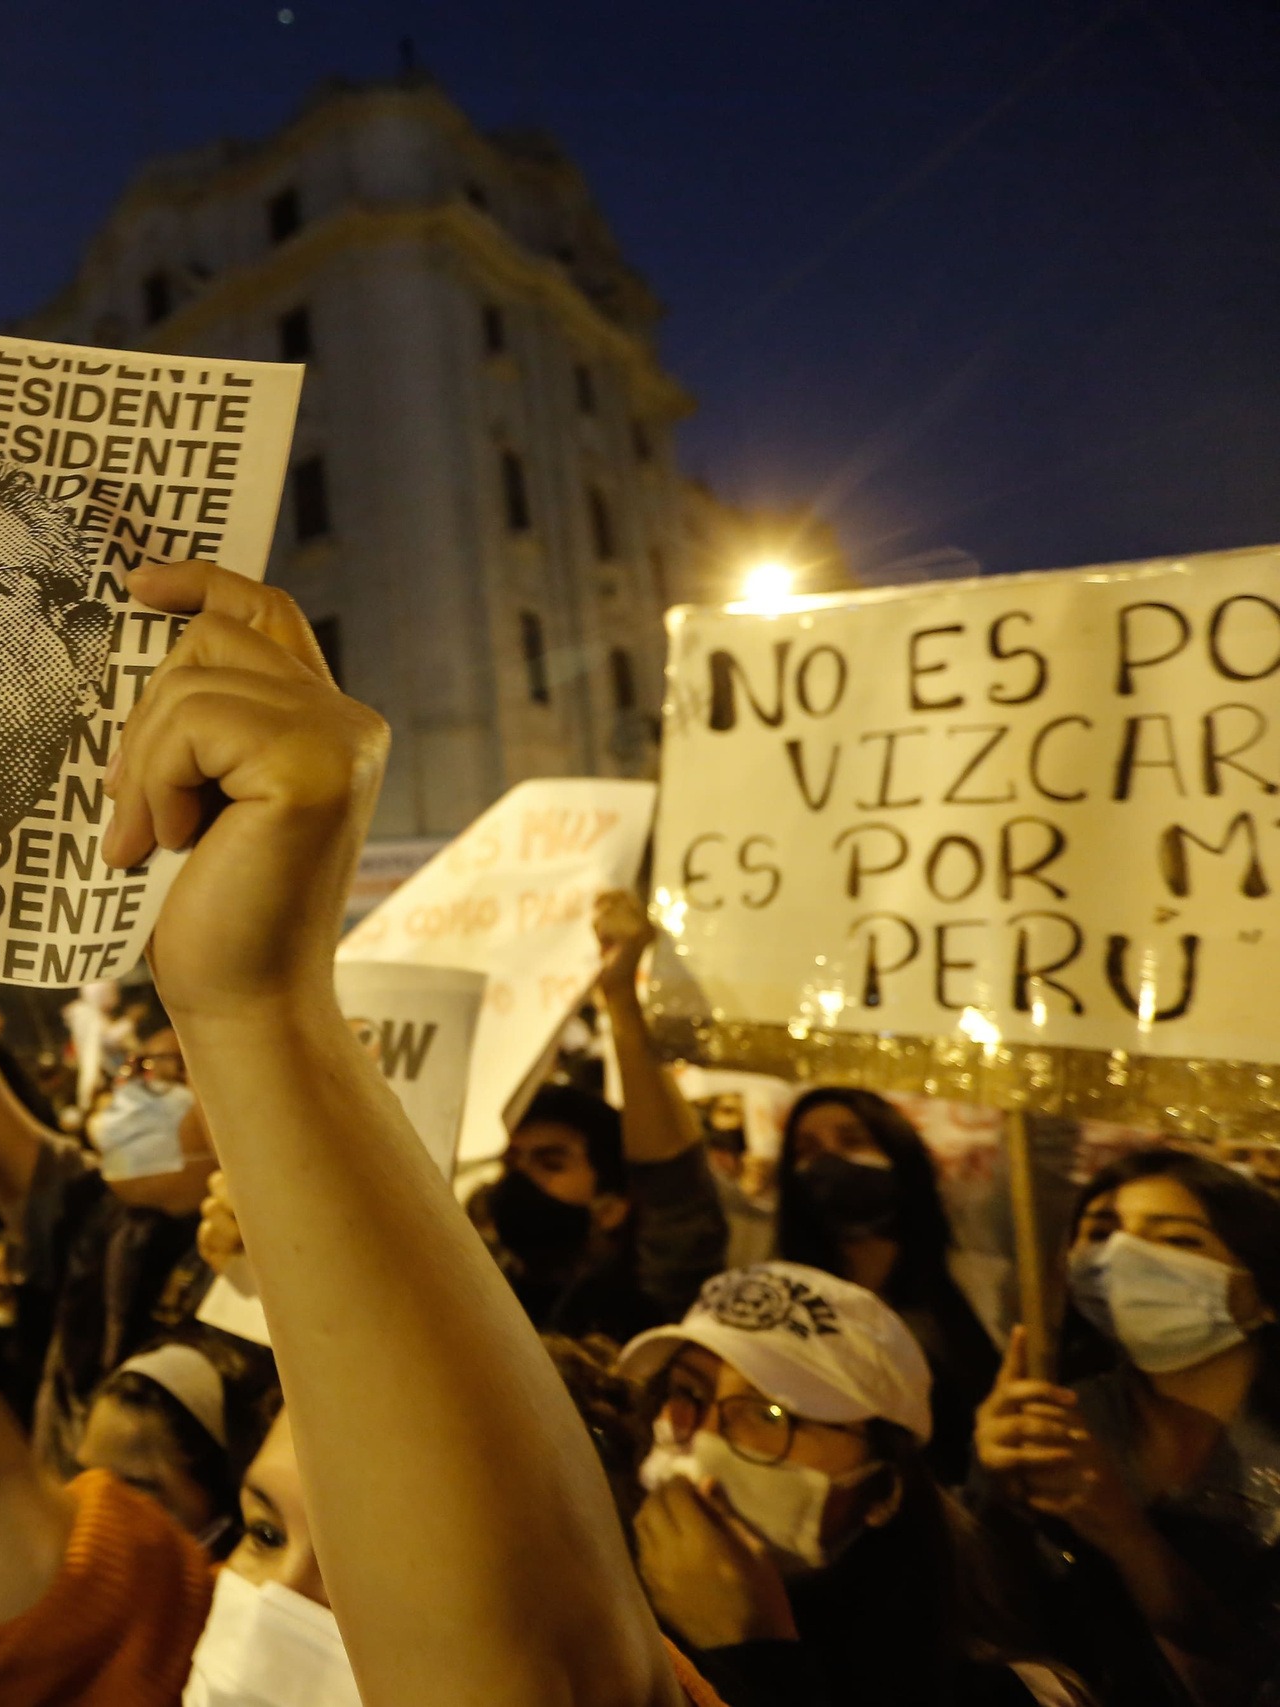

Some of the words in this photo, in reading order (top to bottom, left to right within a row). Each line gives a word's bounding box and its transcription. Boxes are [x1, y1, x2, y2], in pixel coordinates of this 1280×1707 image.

[707, 639, 848, 733] NO
[909, 611, 1049, 713] ES
[682, 832, 782, 911] ES
[833, 815, 1068, 902] POR
[1157, 810, 1280, 899] M
